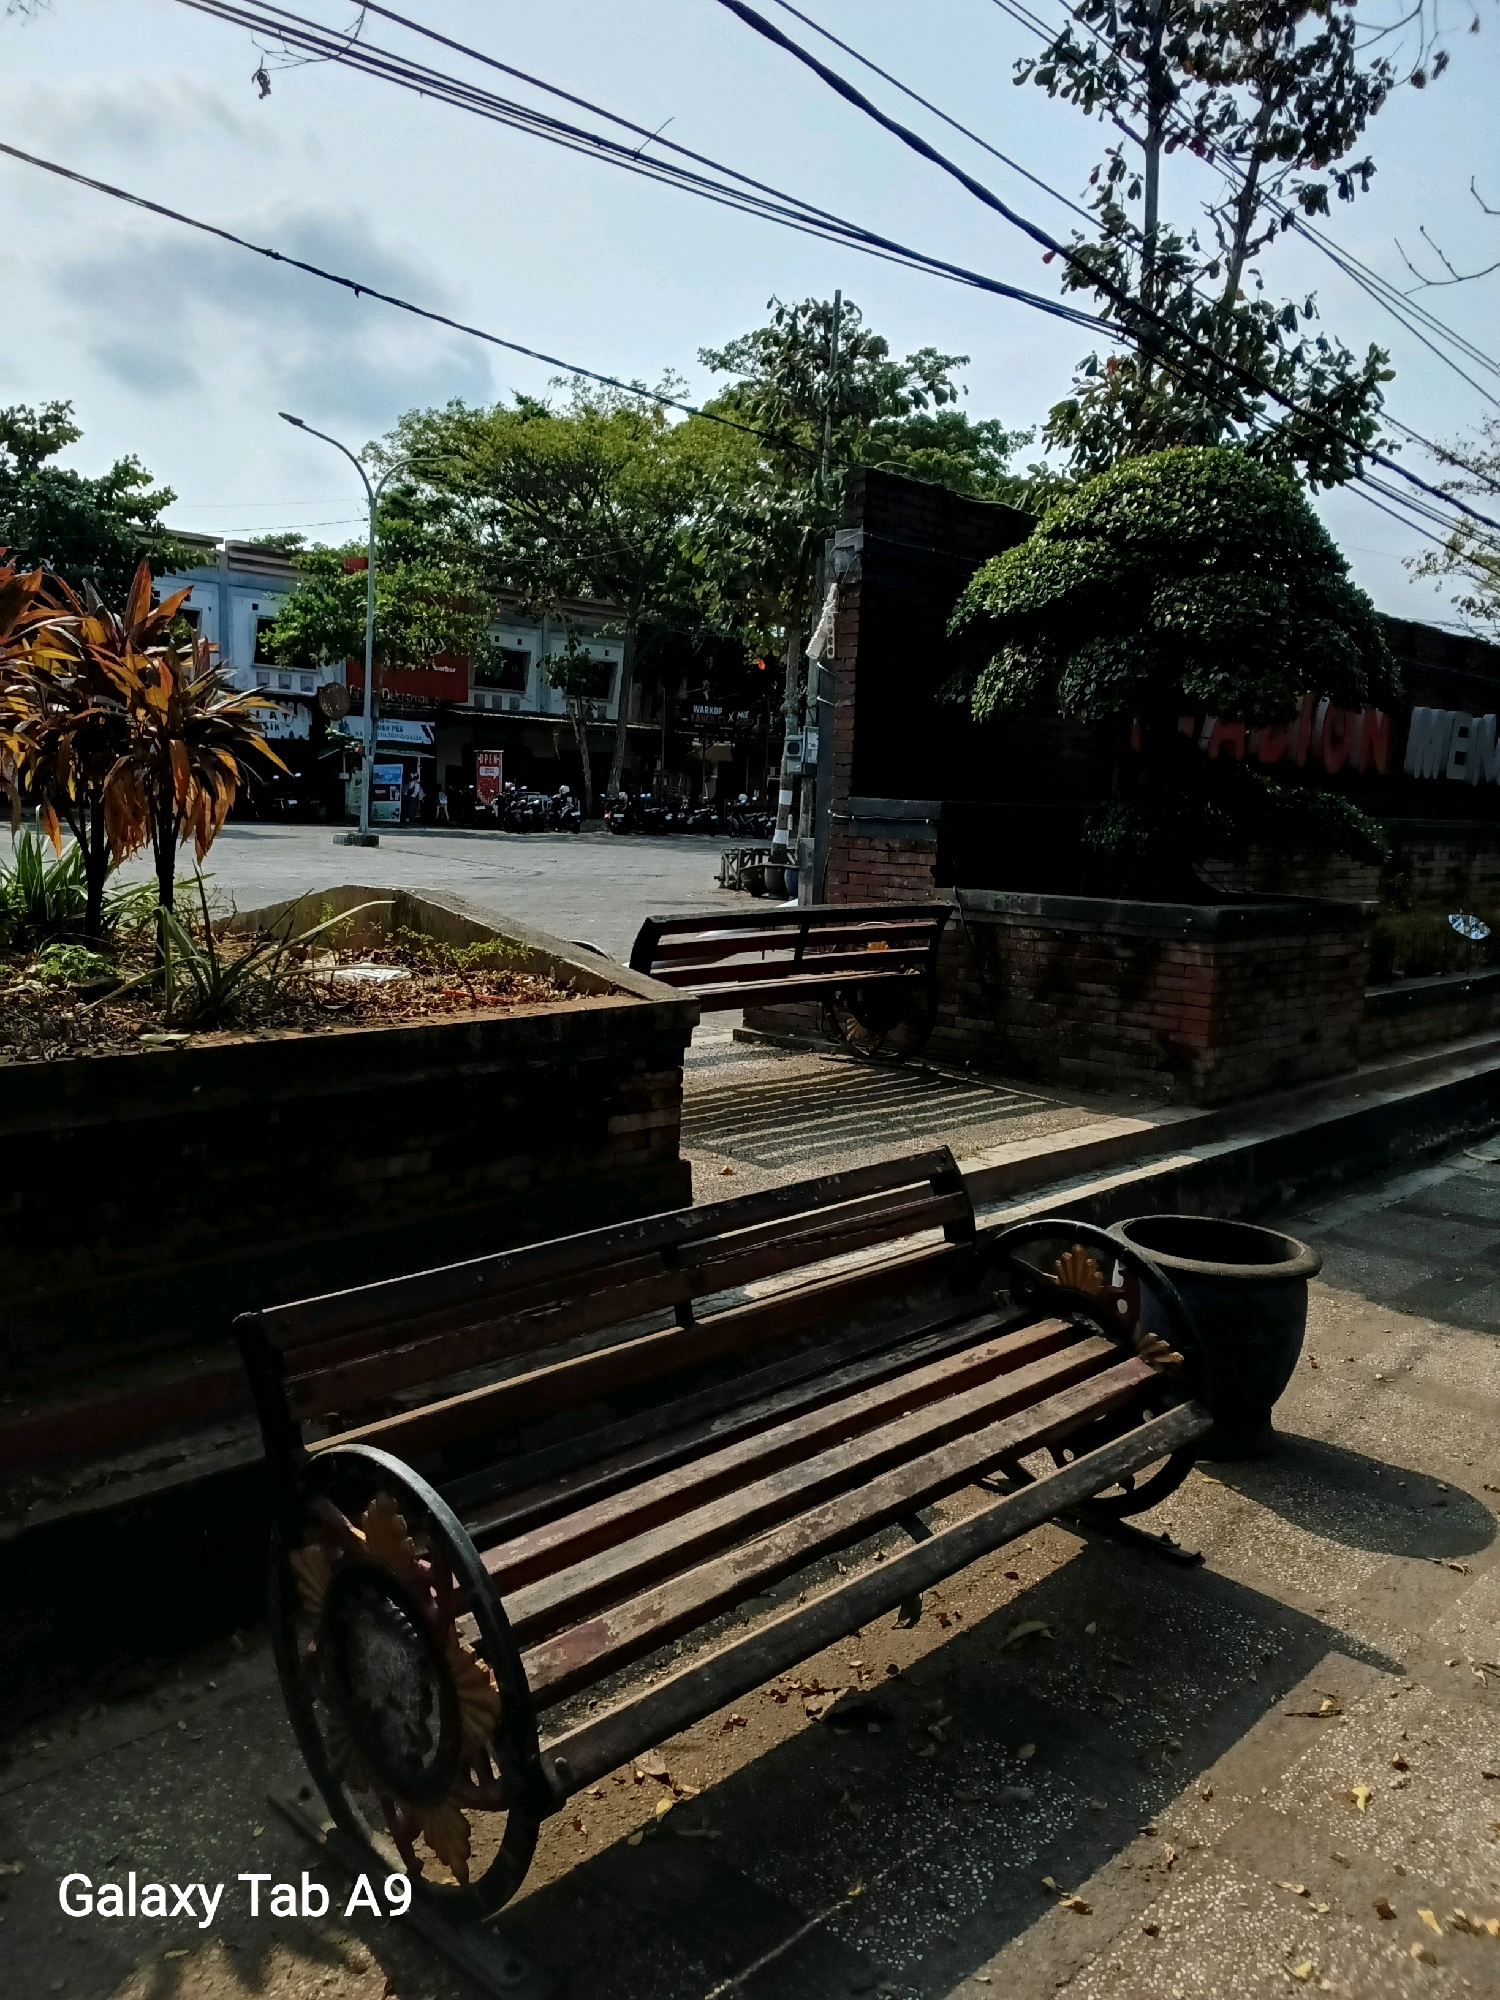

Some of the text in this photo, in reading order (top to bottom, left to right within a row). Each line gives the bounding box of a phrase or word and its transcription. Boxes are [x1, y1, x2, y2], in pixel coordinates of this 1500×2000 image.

[692, 704, 723, 715] WARKOP
[736, 710, 750, 720] MIE
[1403, 706, 1500, 787] MEN
[479, 753, 498, 764] OPEN
